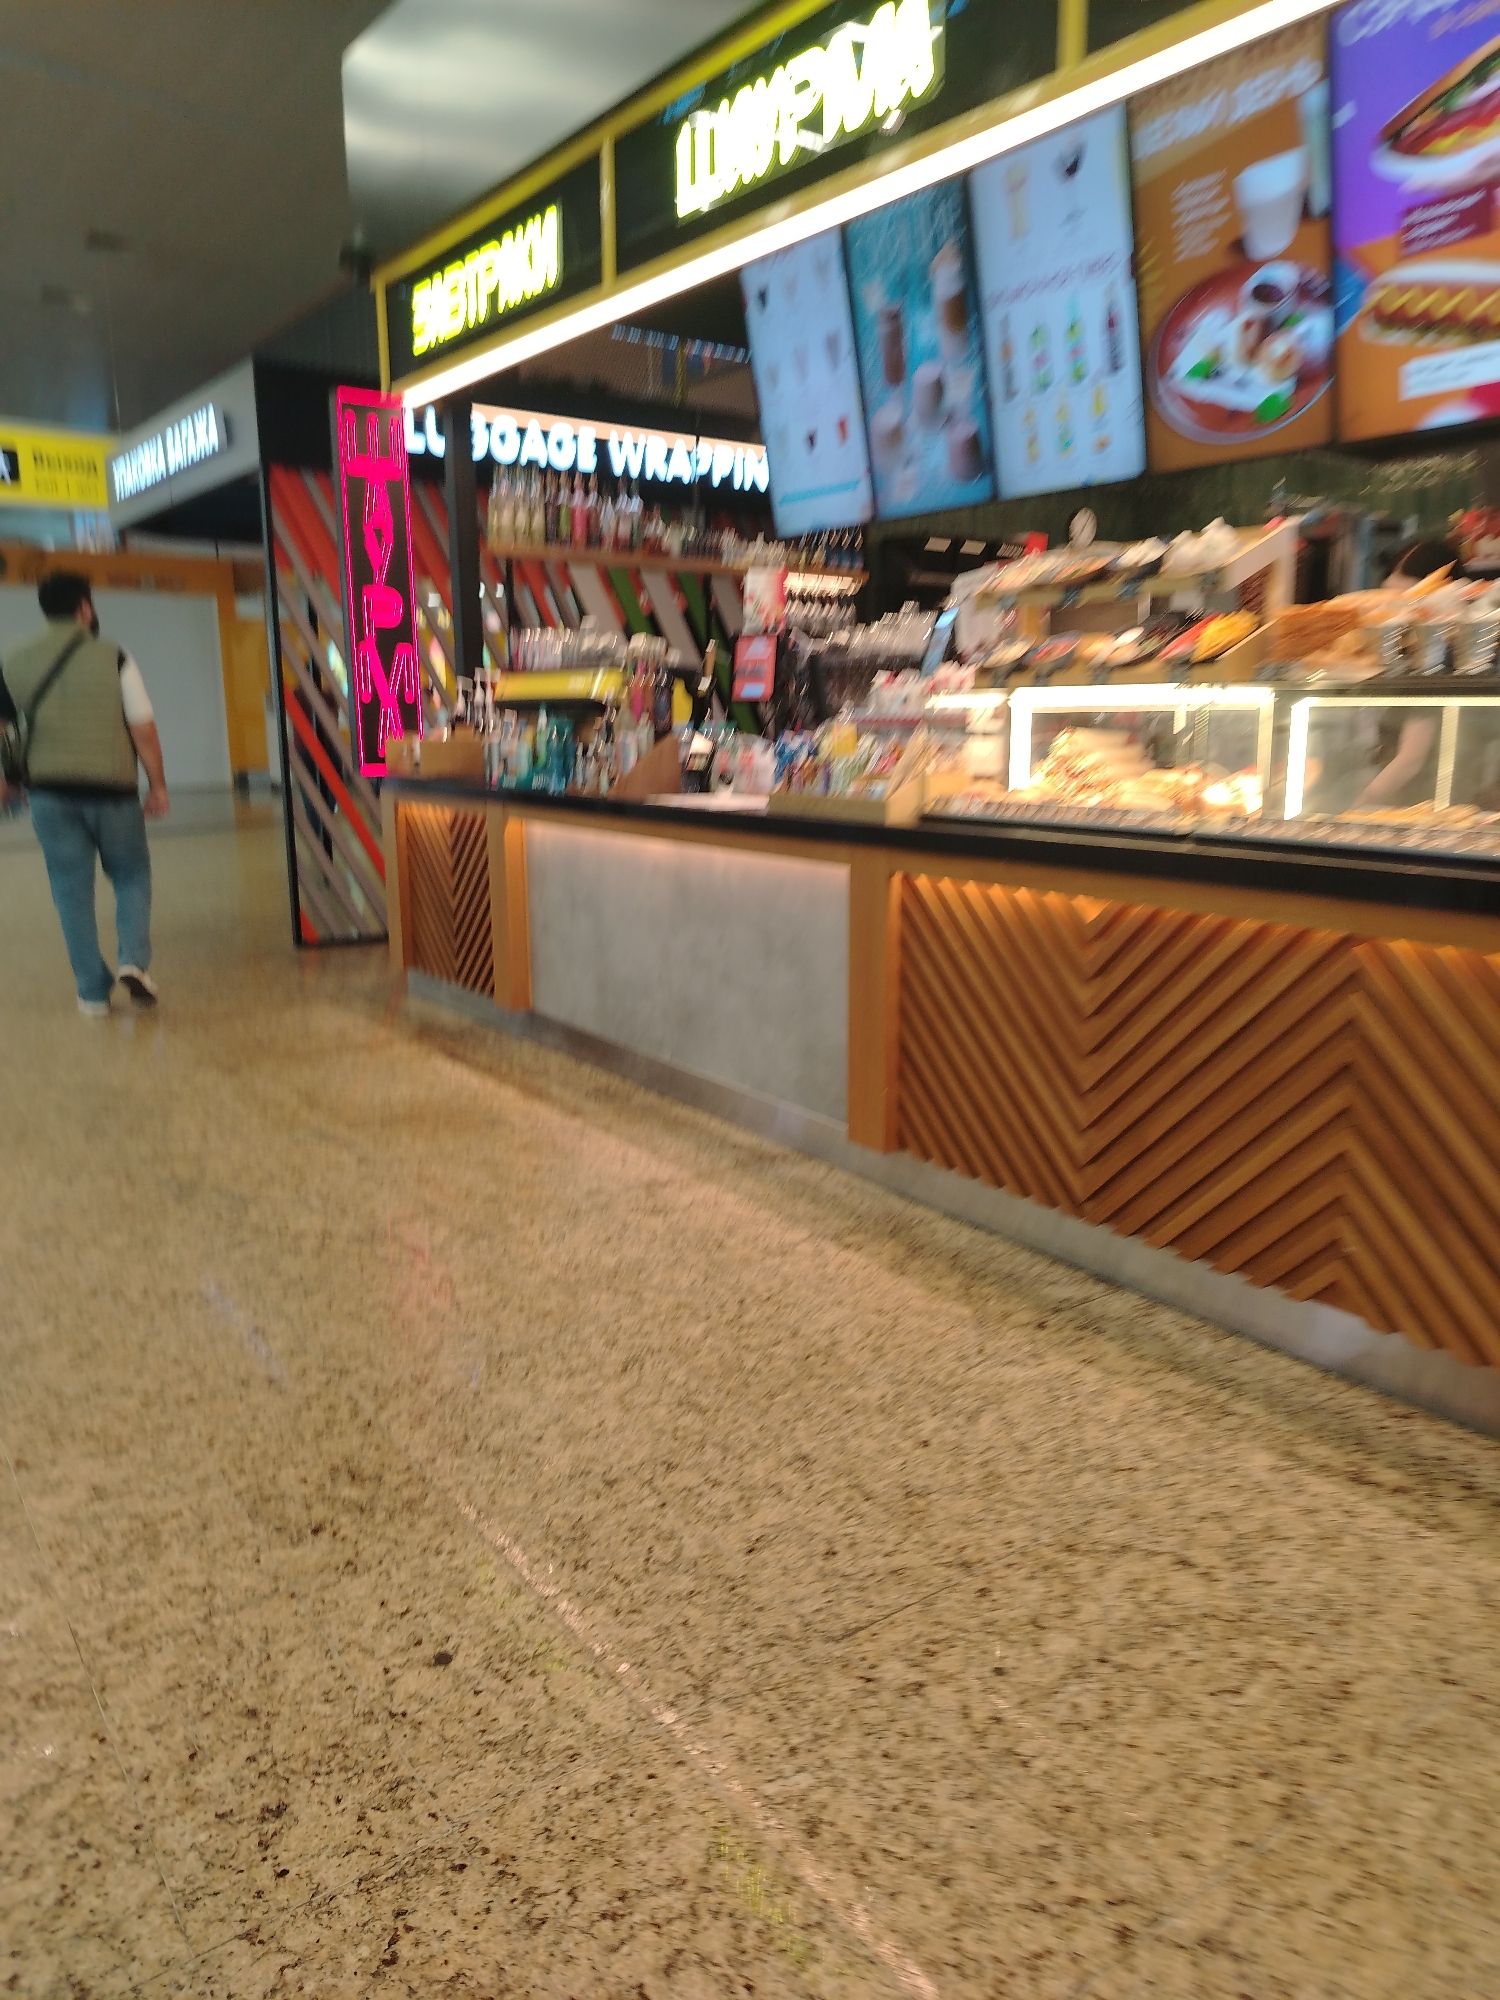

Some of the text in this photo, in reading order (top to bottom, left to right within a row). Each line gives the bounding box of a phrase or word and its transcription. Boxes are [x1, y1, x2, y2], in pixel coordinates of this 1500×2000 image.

[675, 0, 935, 218] ШАУРМА
[412, 203, 558, 357] ЗАВТРАКИ
[112, 402, 219, 503] УПАКОВКА БАГАЖА
